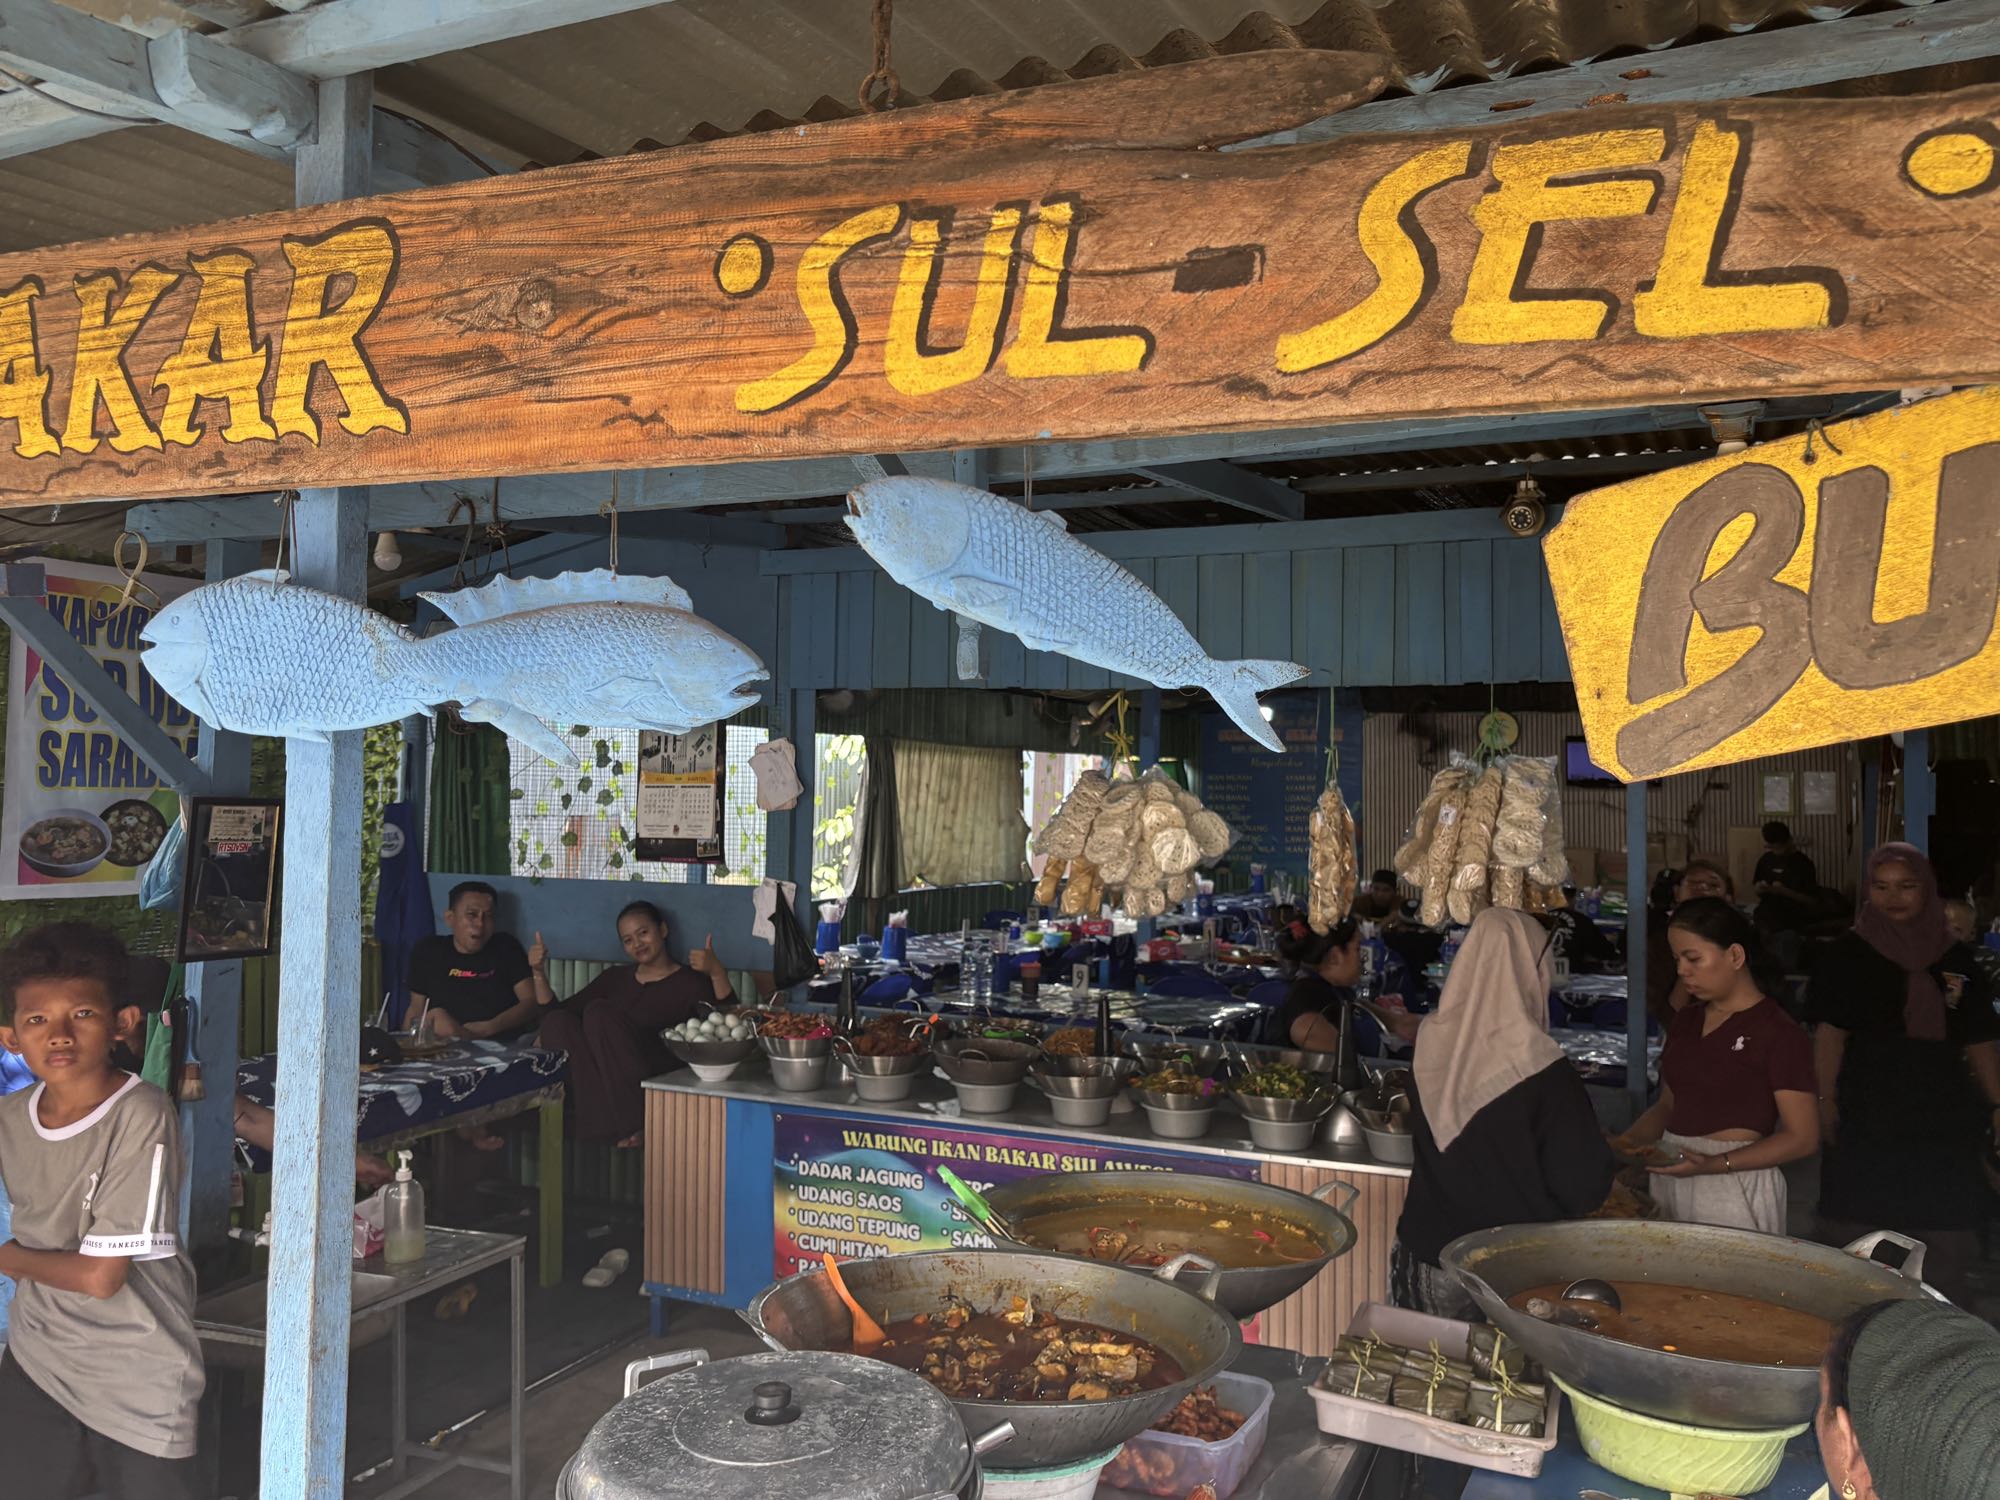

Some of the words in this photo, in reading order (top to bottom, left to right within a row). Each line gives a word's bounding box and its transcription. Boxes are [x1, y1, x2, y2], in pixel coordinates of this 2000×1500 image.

[0, 217, 411, 458] AKAR
[48, 594, 156, 650] KAPUR
[1616, 441, 2000, 777] BU
[39, 730, 198, 787] SARA
[1076, 969, 1085, 989] 9
[842, 1129, 927, 1155] WARUNG
[931, 1139, 981, 1161] IKAN
[985, 1146, 1057, 1171] BAKAR
[798, 1160, 852, 1181] DADAR
[856, 1167, 923, 1190] JAGUNG
[798, 1185, 853, 1206] UDANG
[857, 1192, 902, 1212] SAOS
[798, 1209, 853, 1231] UDANG
[856, 1217, 920, 1240] TEPUNG
[798, 1234, 836, 1253] CUMI
[840, 1239, 888, 1258] HITAM
